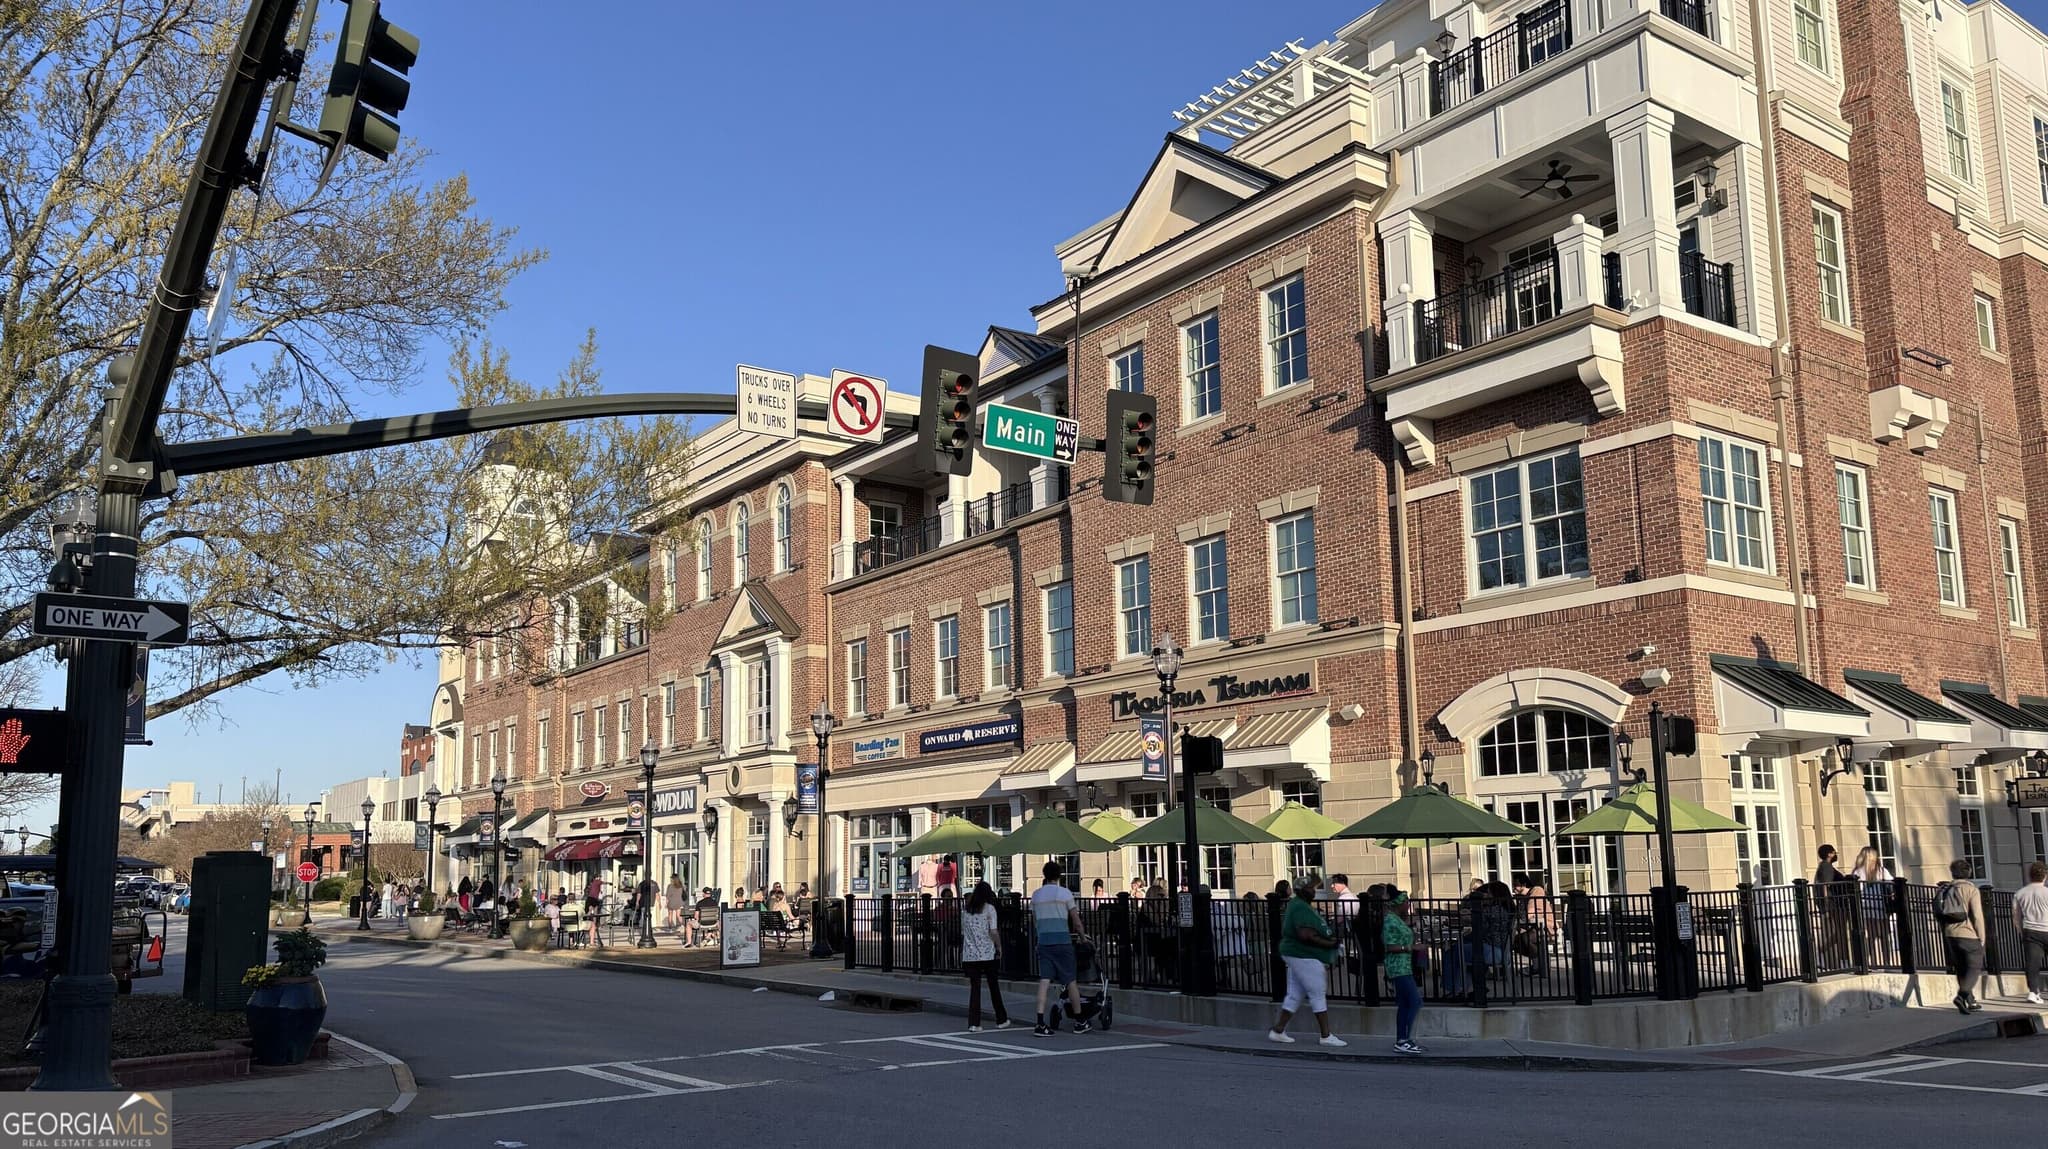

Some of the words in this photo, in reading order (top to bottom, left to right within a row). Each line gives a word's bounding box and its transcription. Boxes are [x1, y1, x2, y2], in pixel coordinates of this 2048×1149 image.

[741, 372, 768, 389] TRUCKS
[772, 378, 791, 393] OVER
[747, 392, 753, 404] 6
[757, 393, 787, 410] WHEELS
[747, 411, 759, 424] NO
[762, 413, 787, 429] TURNS
[1056, 420, 1076, 435] ONE
[996, 415, 1045, 447] Main
[1055, 434, 1076, 449] WAY
[52, 608, 94, 626] ONE
[102, 611, 144, 630] WAY
[1208, 672, 1311, 703] TSUNAMI
[924, 732, 961, 746] ONWARD
[974, 723, 1018, 739] RESERVE
[867, 752, 886, 760] COFFEE
[655, 789, 694, 813] WDUN
[298, 868, 317, 877] STOP
